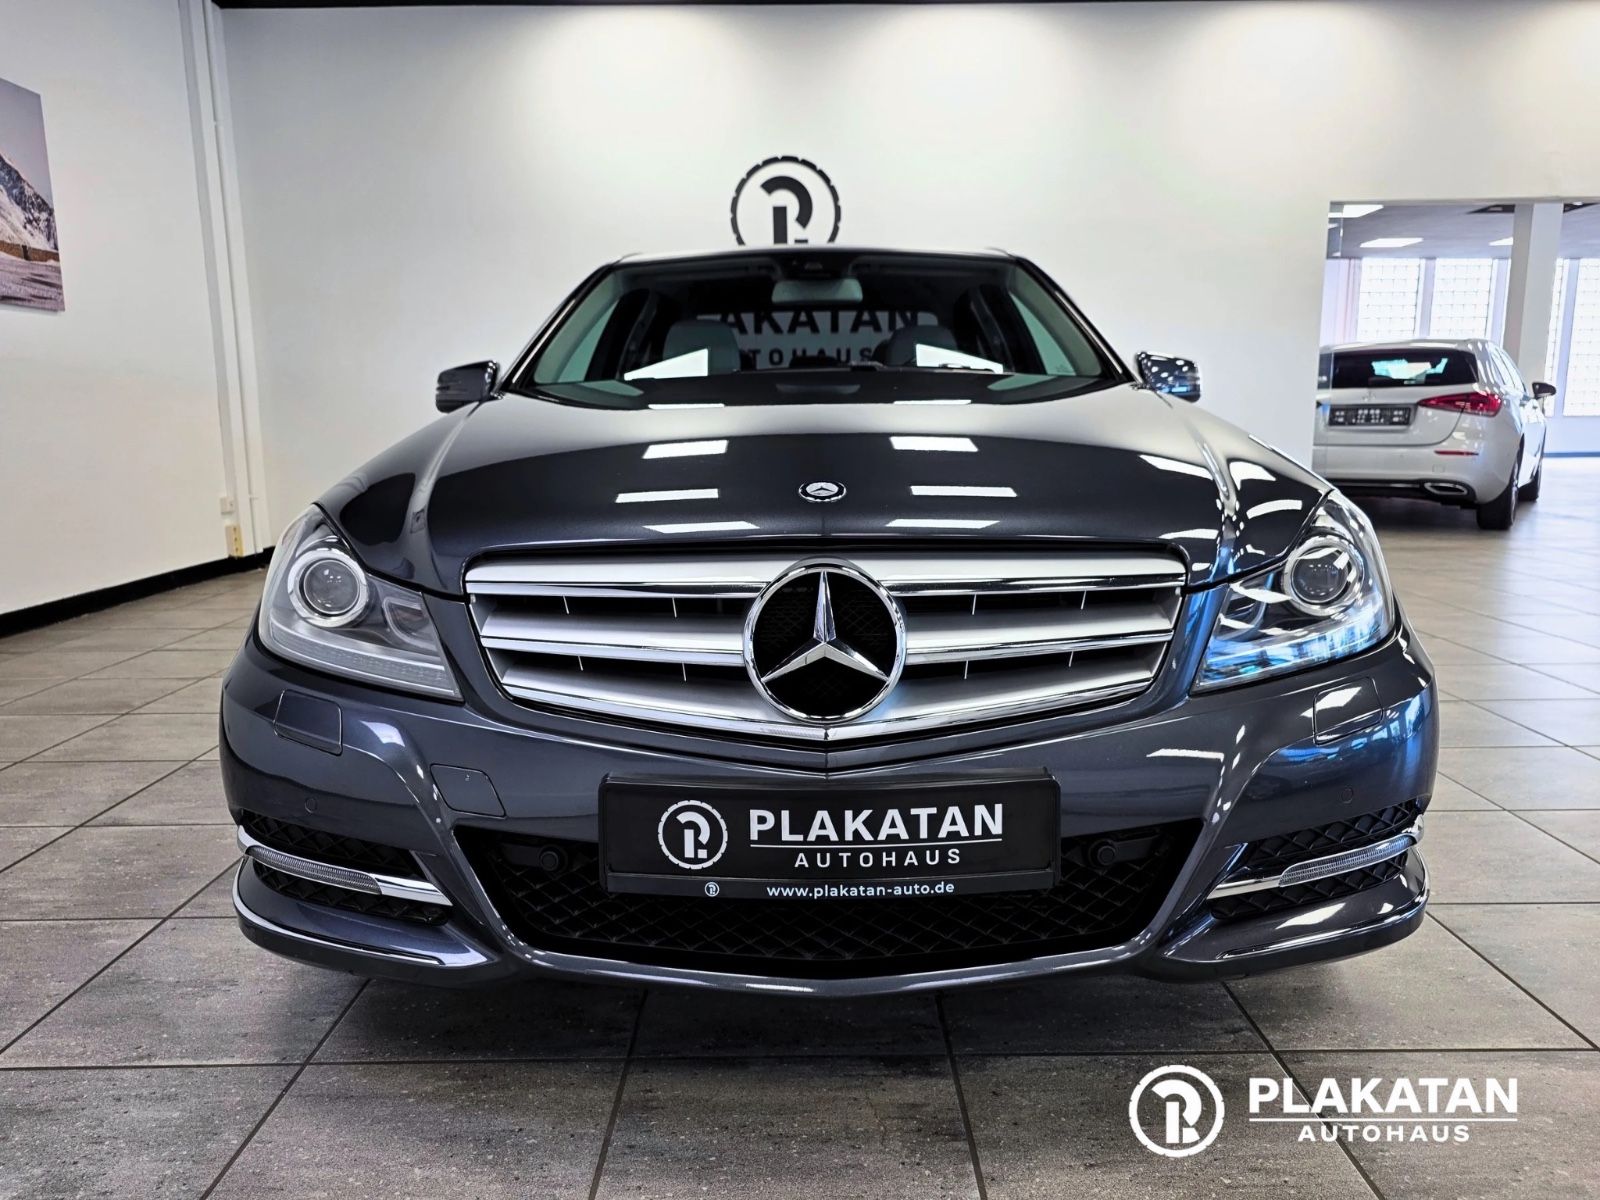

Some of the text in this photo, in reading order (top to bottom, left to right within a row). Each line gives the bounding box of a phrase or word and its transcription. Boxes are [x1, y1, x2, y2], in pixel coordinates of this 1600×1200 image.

[749, 803, 1003, 842] PLAKATAN
[795, 848, 960, 869] AUTOHAUS
[766, 881, 955, 899] www.plakatan-auto.de
